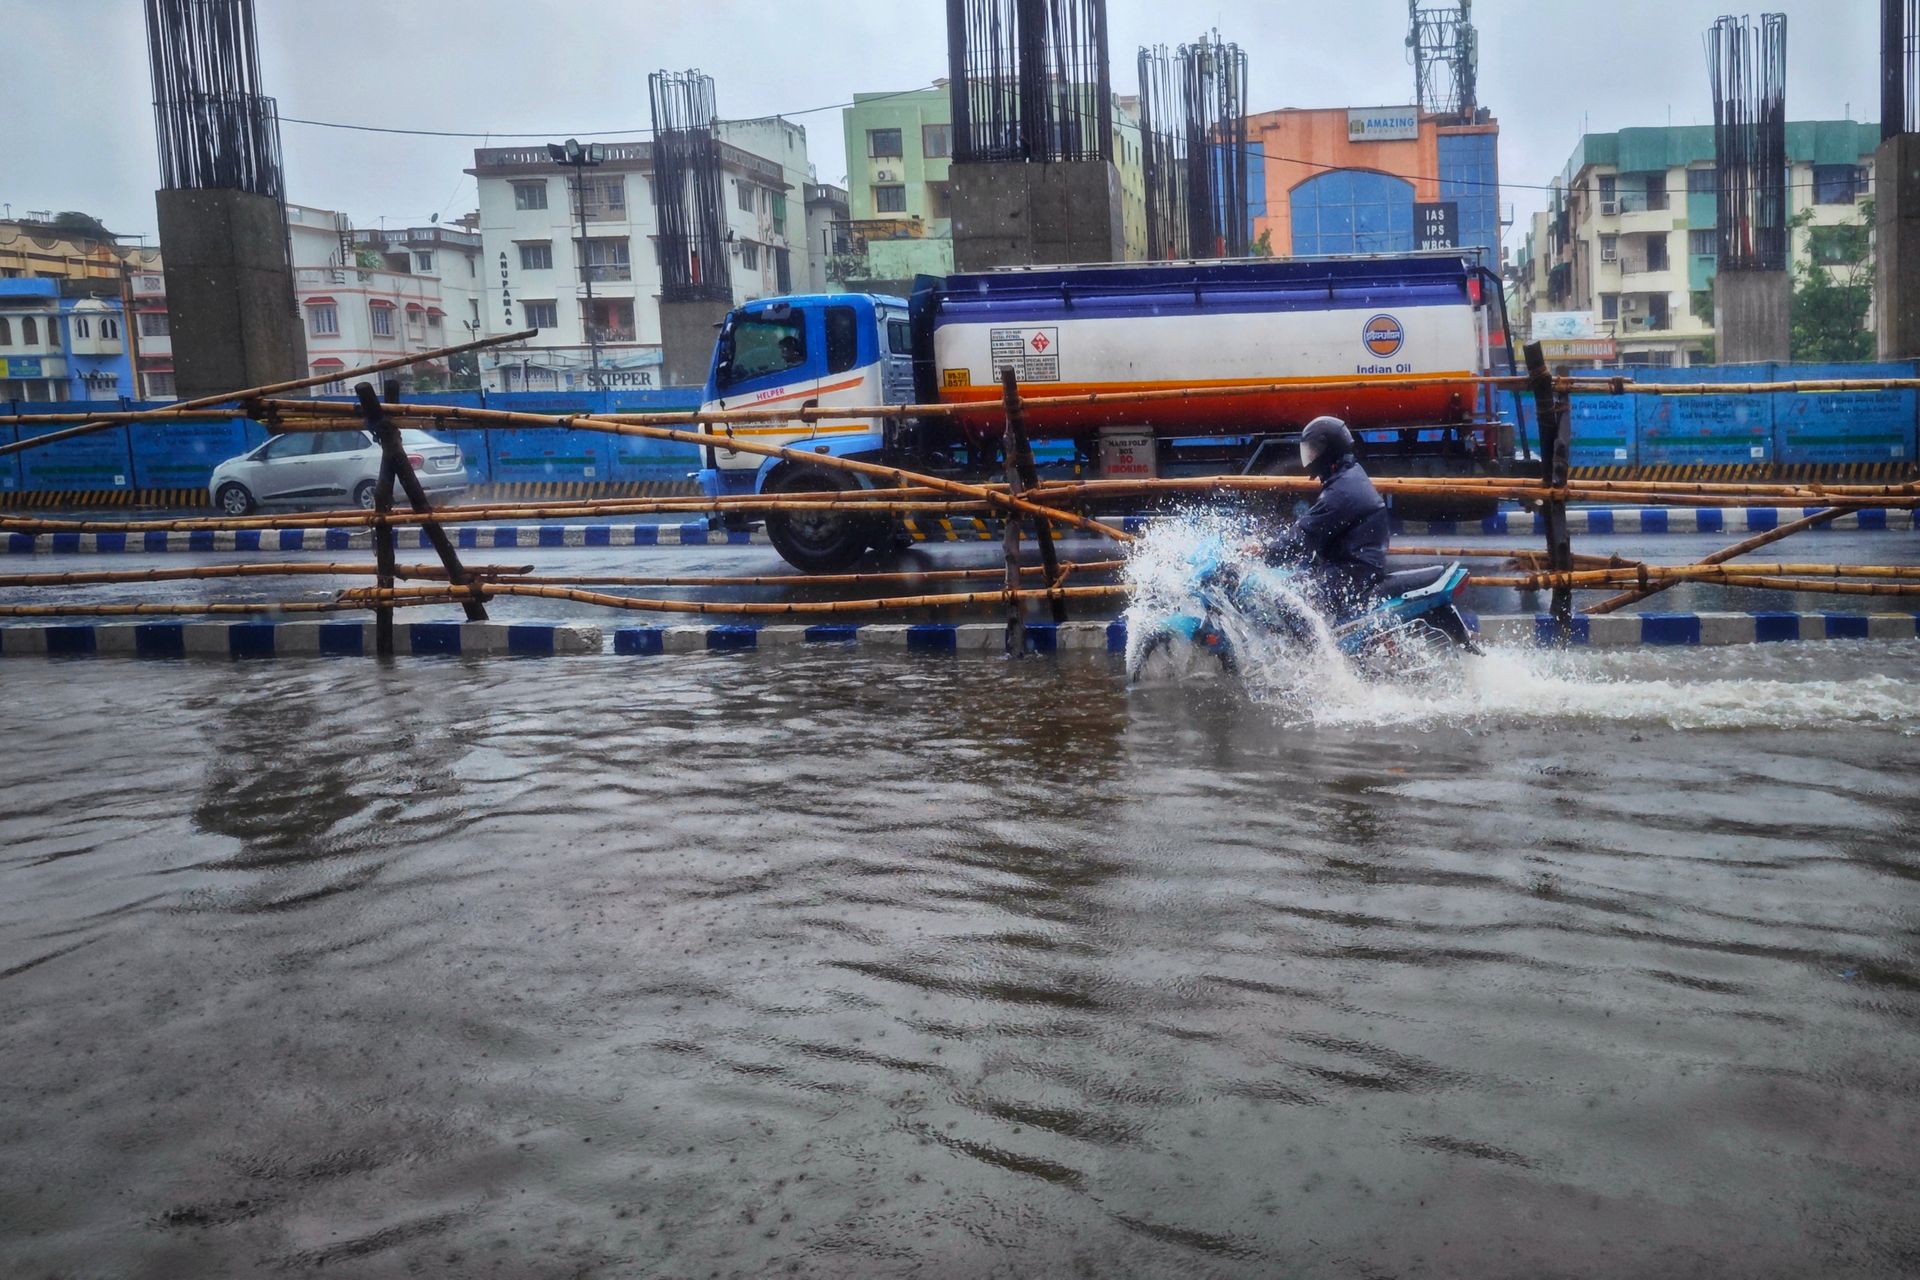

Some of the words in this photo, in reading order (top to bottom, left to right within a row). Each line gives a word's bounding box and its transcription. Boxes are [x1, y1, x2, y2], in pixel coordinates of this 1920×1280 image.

[1366, 117, 1415, 128] AMAZING
[1425, 209, 1444, 221] IAS
[1426, 225, 1445, 236] IPS
[1421, 239, 1452, 251] WBCS
[1356, 364, 1392, 374] Indian
[1395, 364, 1411, 373] Oil
[587, 372, 652, 386] SKIPPER
[756, 387, 785, 401] HELPER
[1120, 455, 1133, 464] NO
